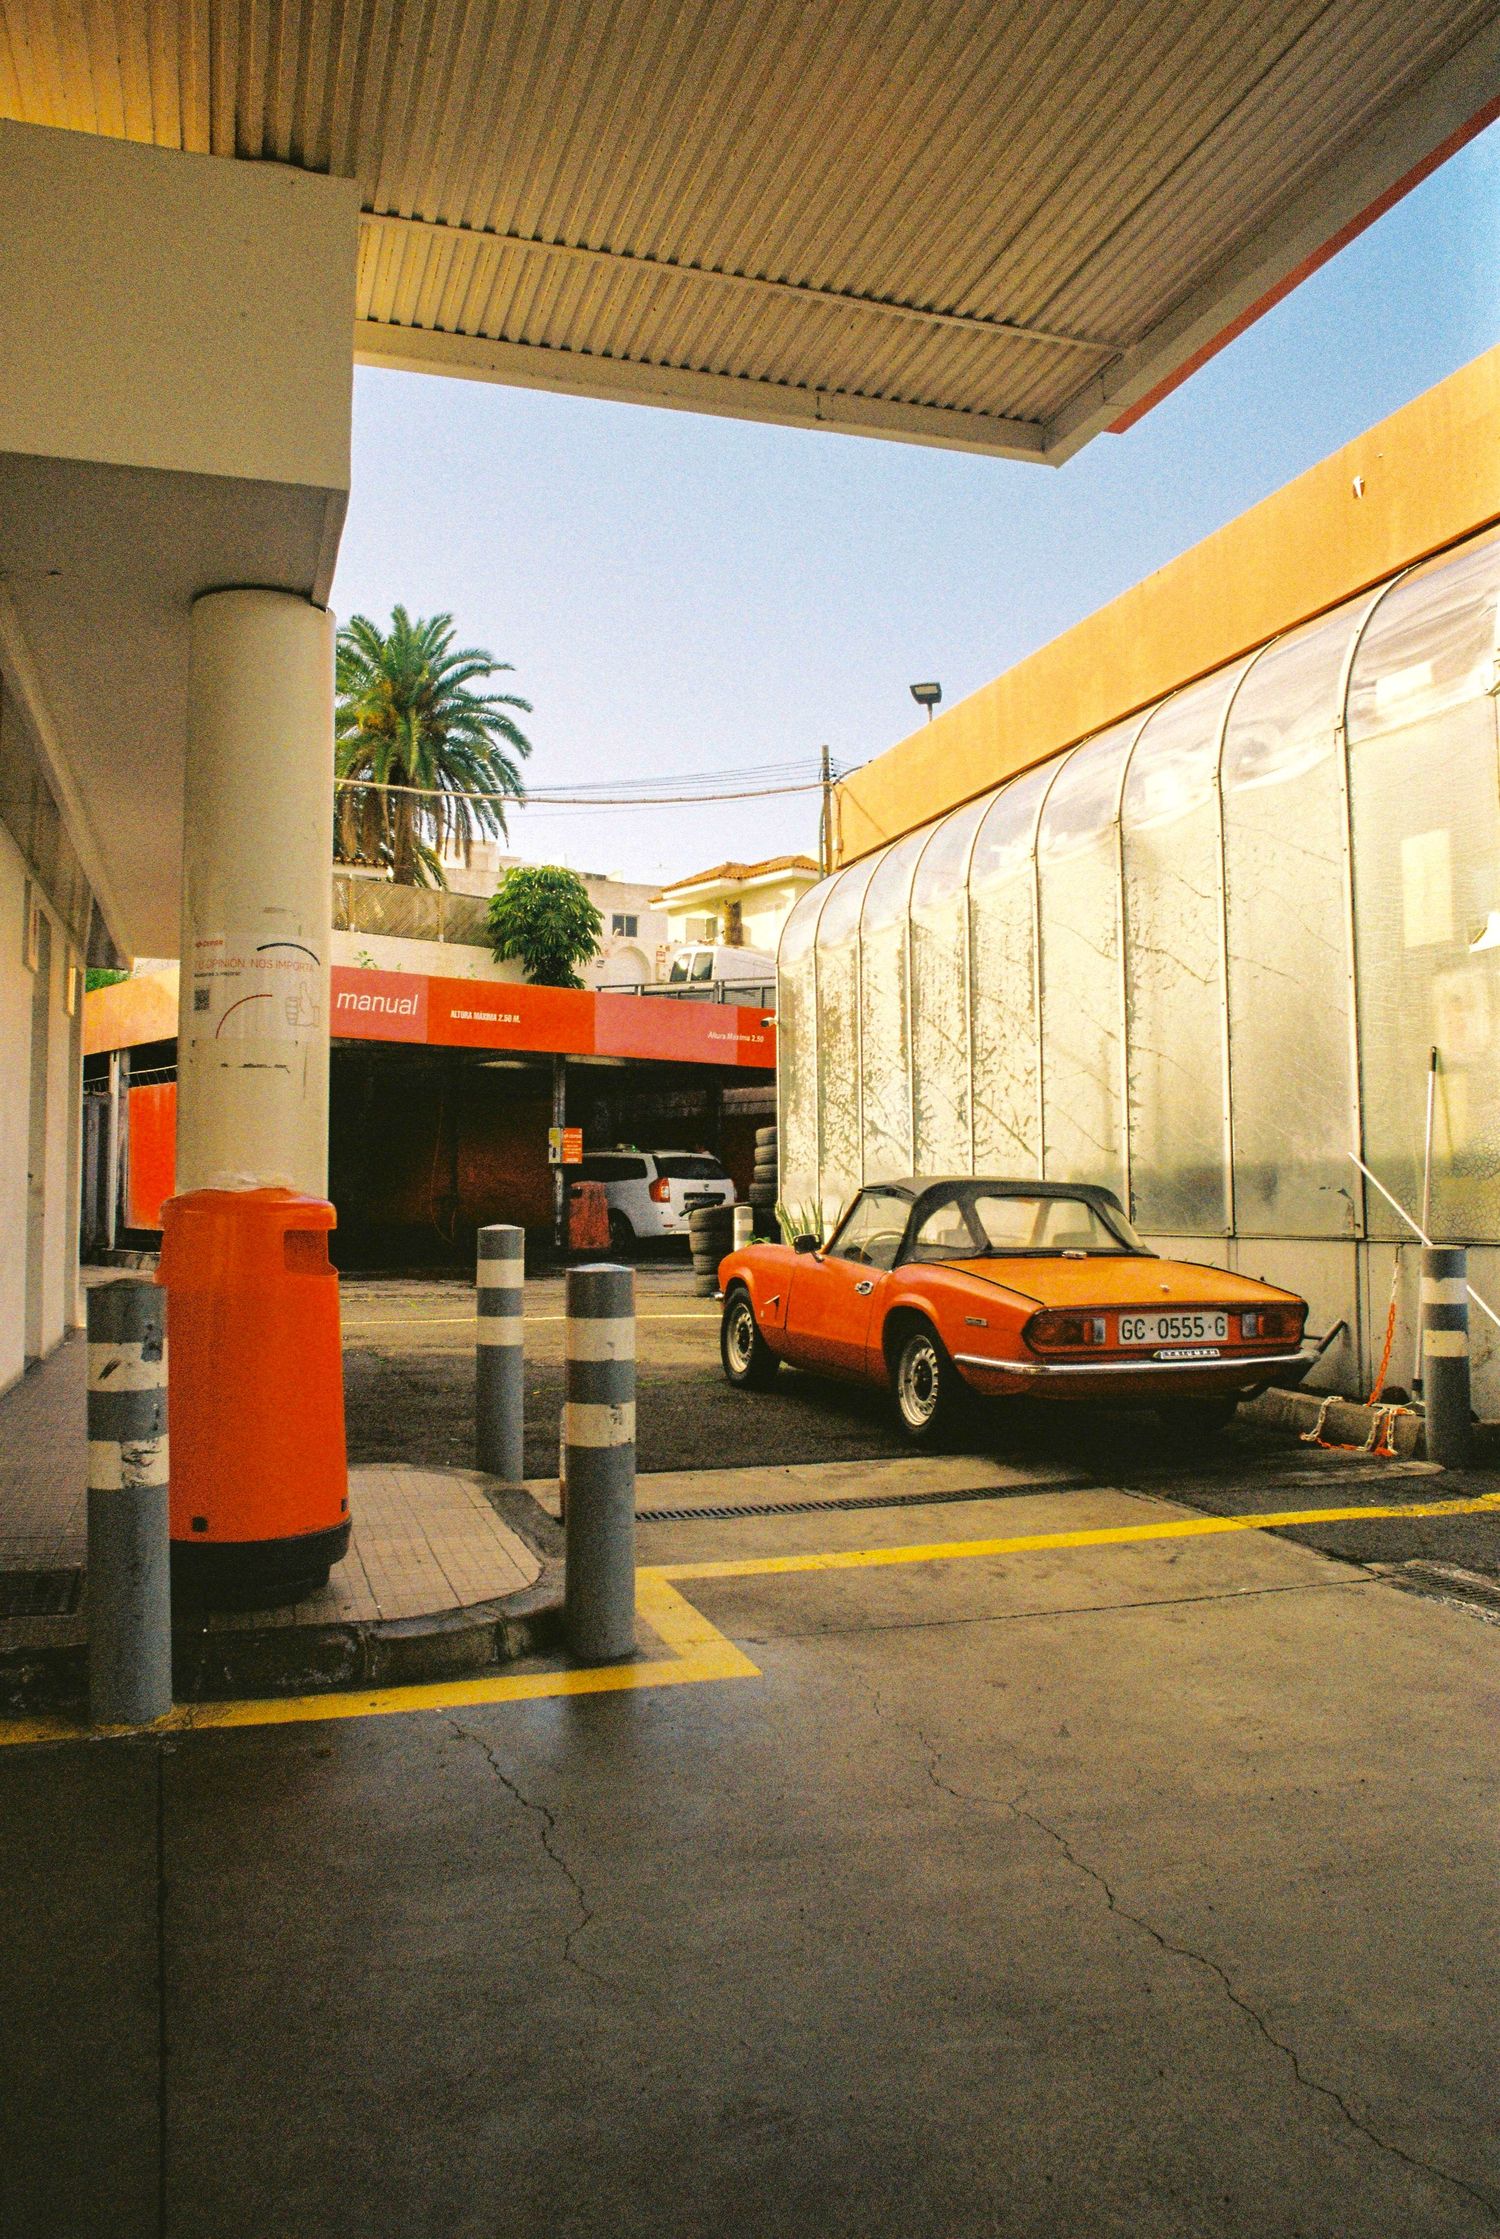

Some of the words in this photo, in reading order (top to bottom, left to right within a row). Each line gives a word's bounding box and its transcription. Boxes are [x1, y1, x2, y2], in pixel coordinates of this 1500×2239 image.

[250, 959, 273, 969] NOS
[336, 992, 418, 1015] manual
[450, 1010, 473, 1020] ALTURA
